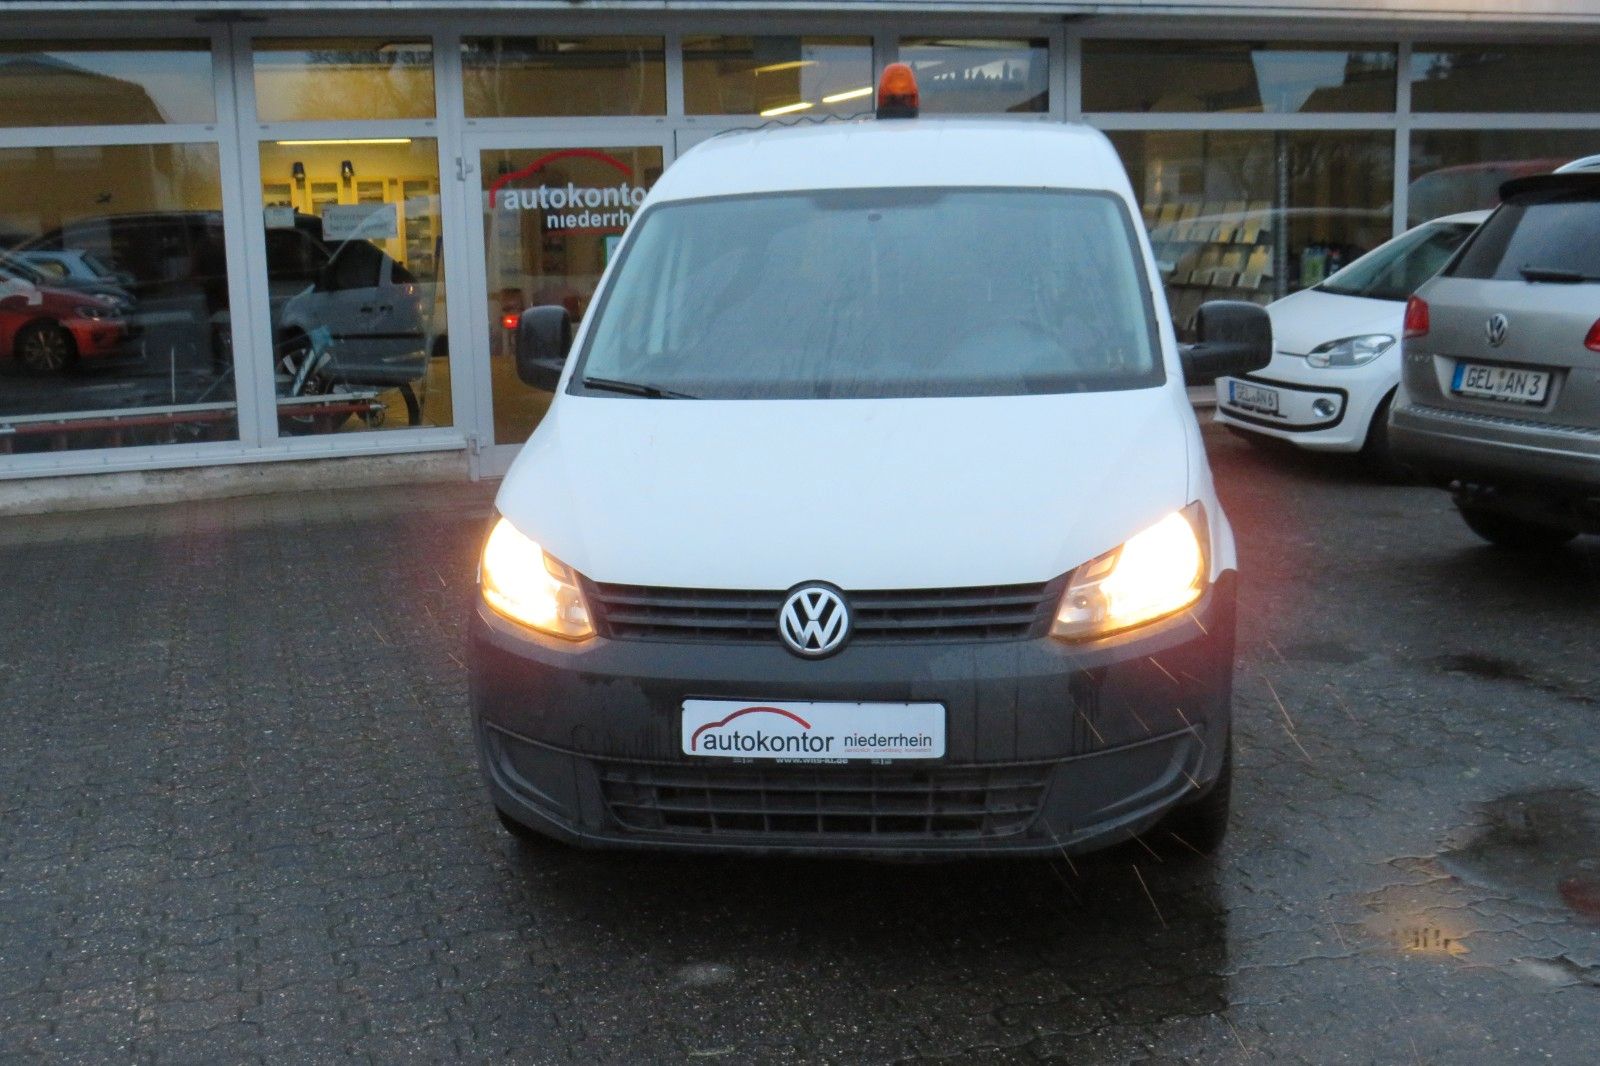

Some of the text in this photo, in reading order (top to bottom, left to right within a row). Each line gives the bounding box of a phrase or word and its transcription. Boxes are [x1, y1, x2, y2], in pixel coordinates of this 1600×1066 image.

[503, 182, 647, 210] autokonto
[547, 210, 630, 228] niederrh
[1466, 367, 1541, 396] GEL AN 3
[780, 587, 849, 655] VW
[703, 730, 932, 753] autokontor niederrhein
